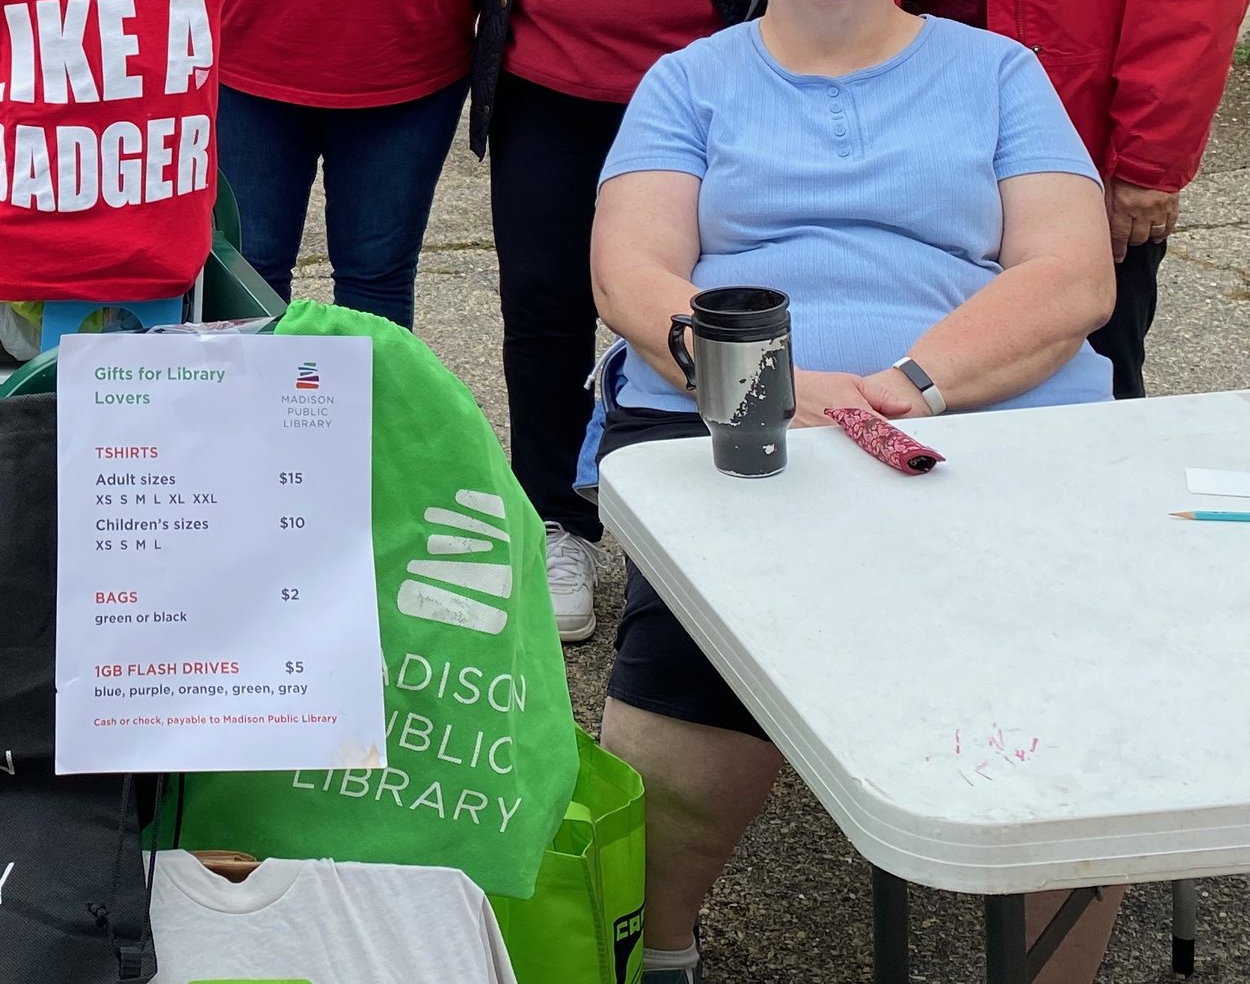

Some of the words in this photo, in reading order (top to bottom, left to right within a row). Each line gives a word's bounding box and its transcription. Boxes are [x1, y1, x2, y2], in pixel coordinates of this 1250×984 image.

[95, 367, 132, 380] Gifts
[139, 367, 162, 380] for
[168, 367, 225, 383] Library
[95, 392, 150, 404] Lovers
[281, 395, 334, 404] MADISON
[288, 408, 328, 416] PUBLIC
[284, 420, 332, 428] LIBRARY
[95, 447, 158, 458] TSHIRTS
[96, 473, 135, 485] Adult
[141, 473, 175, 485] sizes
[280, 472, 302, 485] $15
[97, 495, 111, 505] XS
[121, 495, 127, 504] S
[136, 495, 145, 504] M
[154, 494, 161, 504] L
[169, 494, 185, 504] XL
[193, 494, 217, 503] XXL
[174, 518, 208, 529] sizes
[280, 517, 305, 530] $10
[96, 540, 111, 550] XS
[121, 540, 127, 550] S
[136, 540, 145, 550] M
[155, 540, 161, 549] L
[96, 592, 137, 603] BAGS
[282, 588, 299, 601] $2
[95, 615, 131, 625] green
[154, 612, 187, 622] black
[95, 665, 122, 677] 1GB
[128, 663, 176, 676] FLASH
[183, 662, 238, 674] DRIVES
[286, 661, 303, 674] $5
[95, 686, 125, 697] blue,
[130, 684, 174, 697] purple,
[179, 686, 227, 696] orange,
[233, 685, 274, 695] green,
[279, 685, 307, 695] gray
[94, 718, 116, 726] Cash
[133, 716, 163, 726] check,
[167, 716, 206, 726] payable
[210, 716, 221, 724] to
[224, 715, 264, 723] Madison
[268, 715, 298, 723] Public
[302, 715, 337, 724] Library
